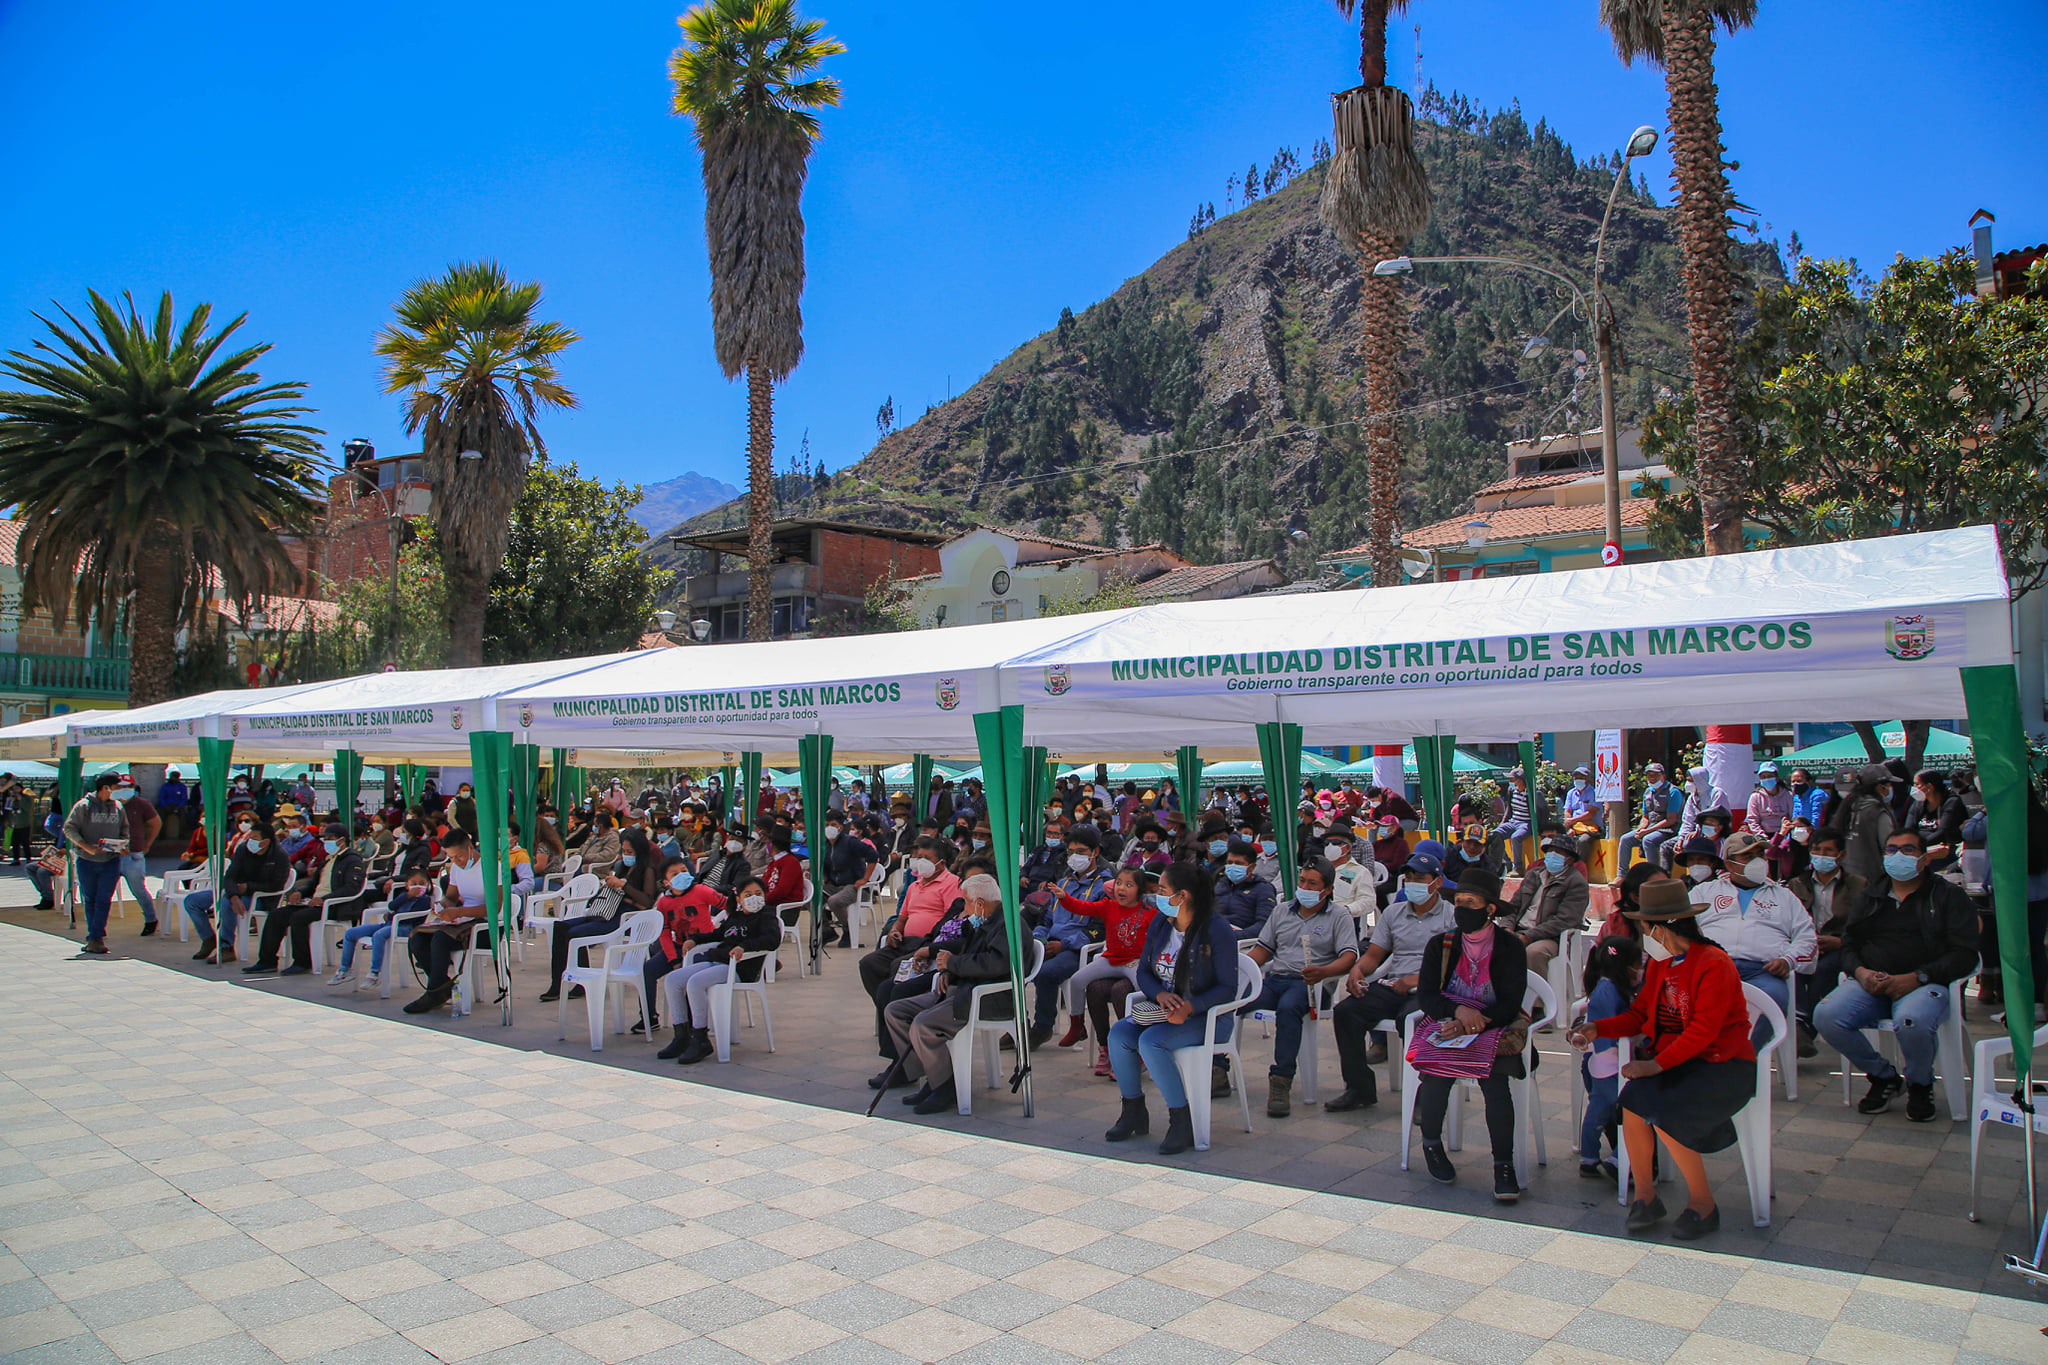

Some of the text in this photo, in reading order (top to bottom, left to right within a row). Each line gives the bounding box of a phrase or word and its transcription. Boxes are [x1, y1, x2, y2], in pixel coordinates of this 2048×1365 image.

[1111, 621, 1813, 682] MUNICIPALIDAD DISTRITAL DE SAN MARCOS
[1226, 660, 1643, 692] Gobierno transparente con oportunidad para todos
[553, 682, 901, 717] MUNICIPALIDAD DISTRITAL DE SAN MARCOS
[249, 708, 434, 730] MUNICIPALIDAD DISTRITAL DE SAN MARCOS
[612, 708, 818, 726] Gobierno transparente con oportunidad para todos
[1782, 757, 1861, 766] MUNICIPALIDAD
[1932, 753, 1954, 761] SAN
